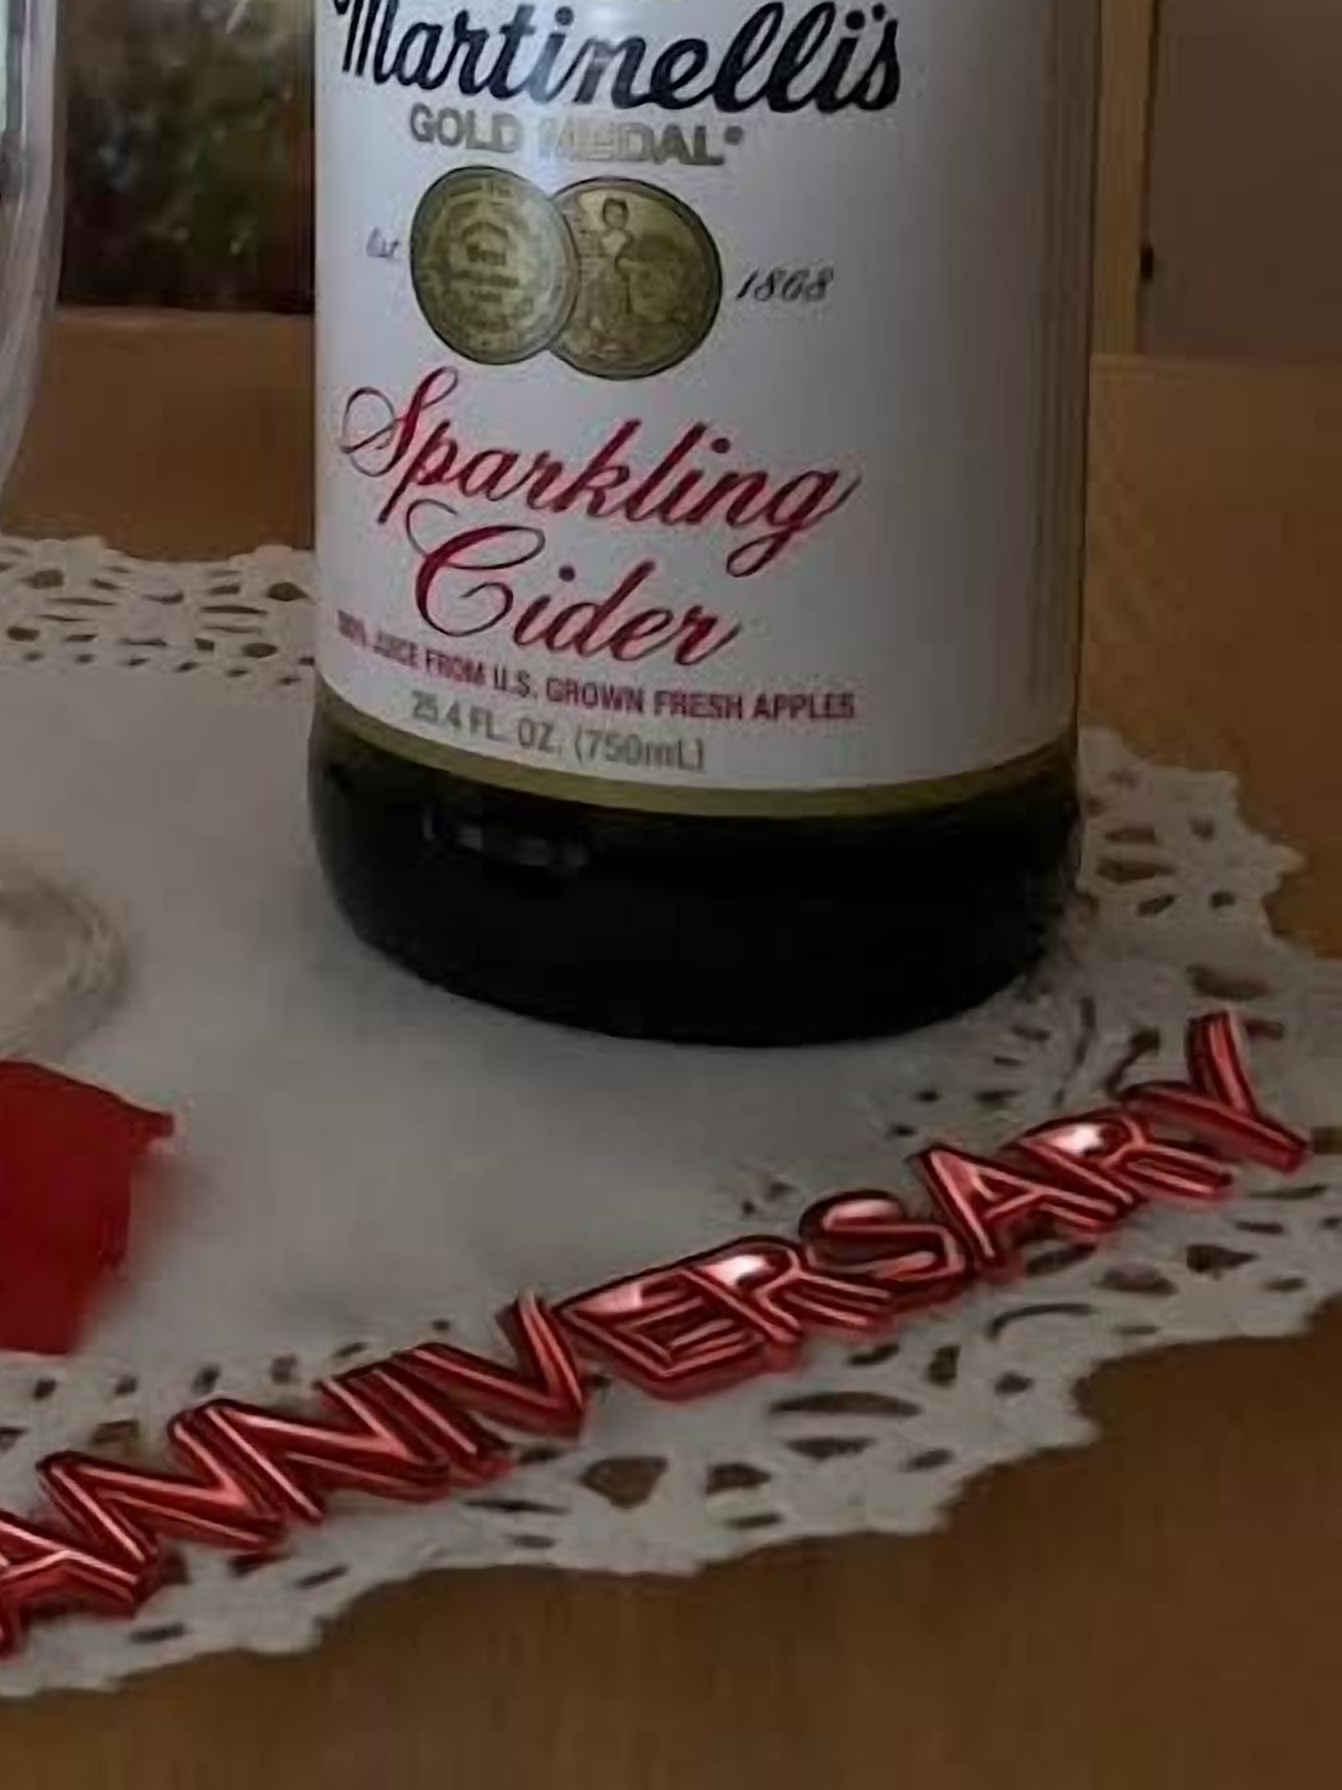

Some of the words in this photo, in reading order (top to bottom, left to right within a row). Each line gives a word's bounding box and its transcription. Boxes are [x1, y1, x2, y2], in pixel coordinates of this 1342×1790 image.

[410, 102, 524, 154] GOLD
[538, 118, 725, 166] MEDAL
[340, 365, 862, 580] Sparkling
[404, 498, 743, 668] Cider
[425, 648, 487, 687] FROM
[545, 676, 645, 716] GROWN
[653, 688, 744, 721] FRESH
[752, 692, 856, 723] APPLES
